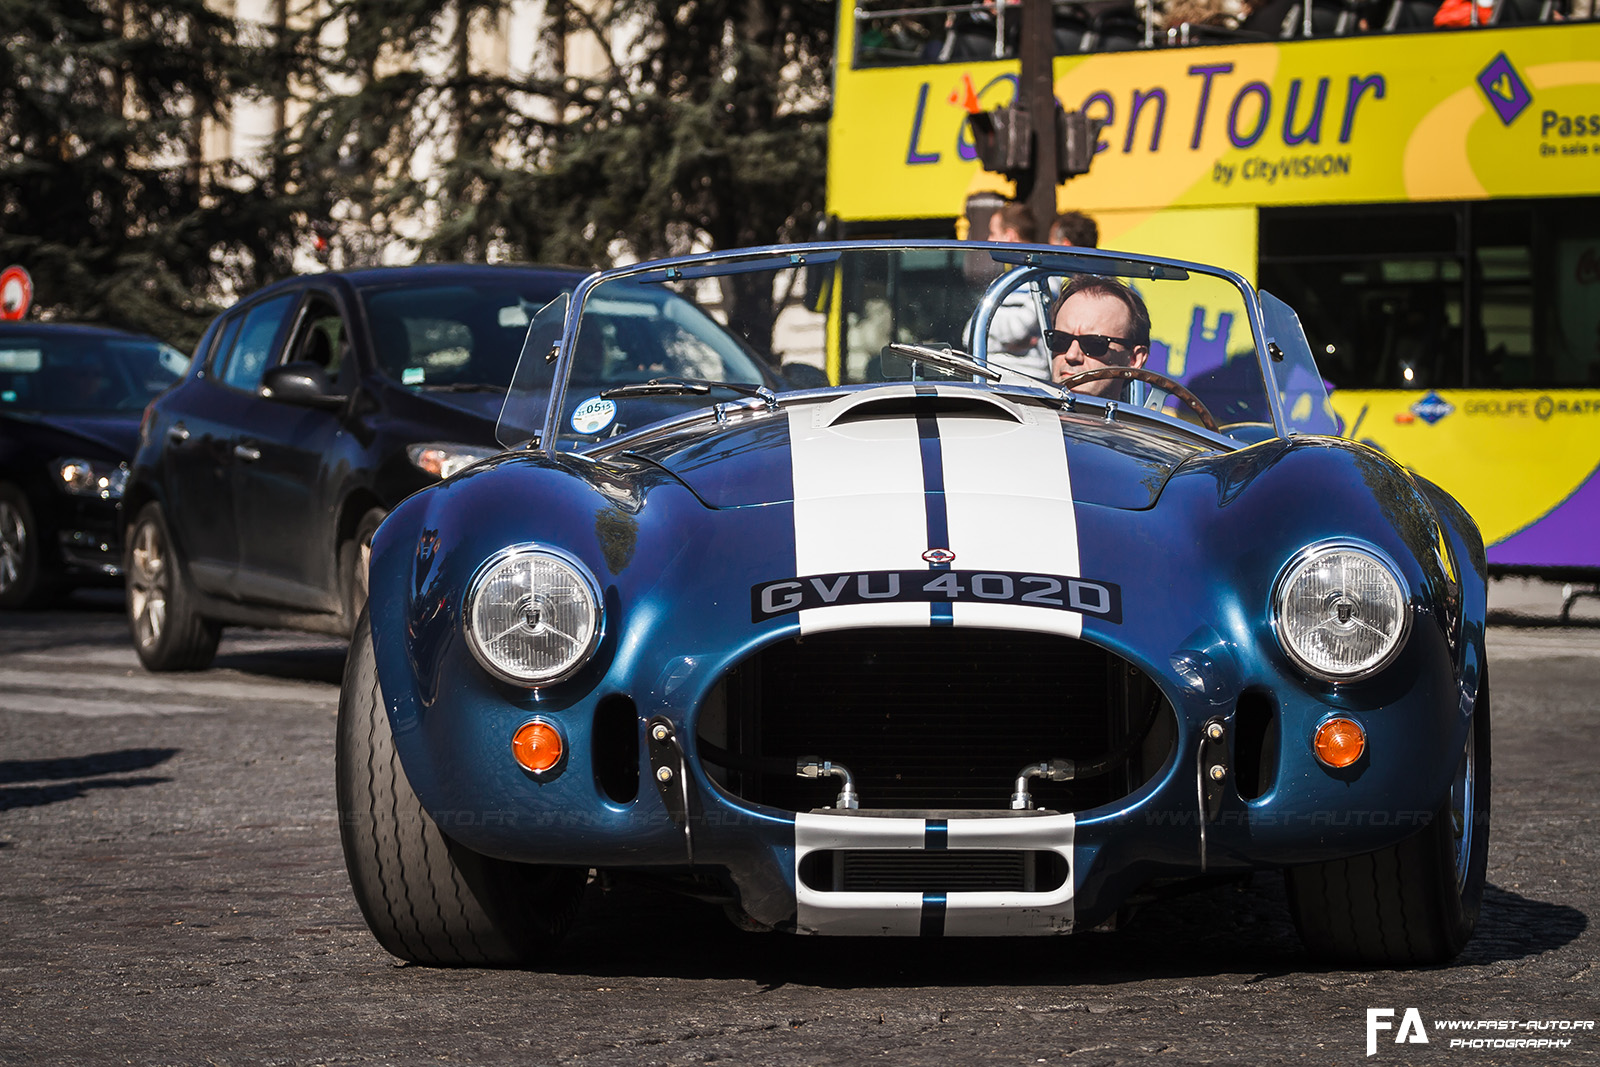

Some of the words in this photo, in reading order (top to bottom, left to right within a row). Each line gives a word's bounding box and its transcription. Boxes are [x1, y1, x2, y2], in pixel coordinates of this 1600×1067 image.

[1541, 109, 1600, 138] Pass
[1213, 159, 1235, 186] by
[1242, 154, 1351, 185] CityVISION
[587, 403, 601, 413] 05
[761, 573, 900, 614] GVU
[922, 573, 1111, 614] 402D
